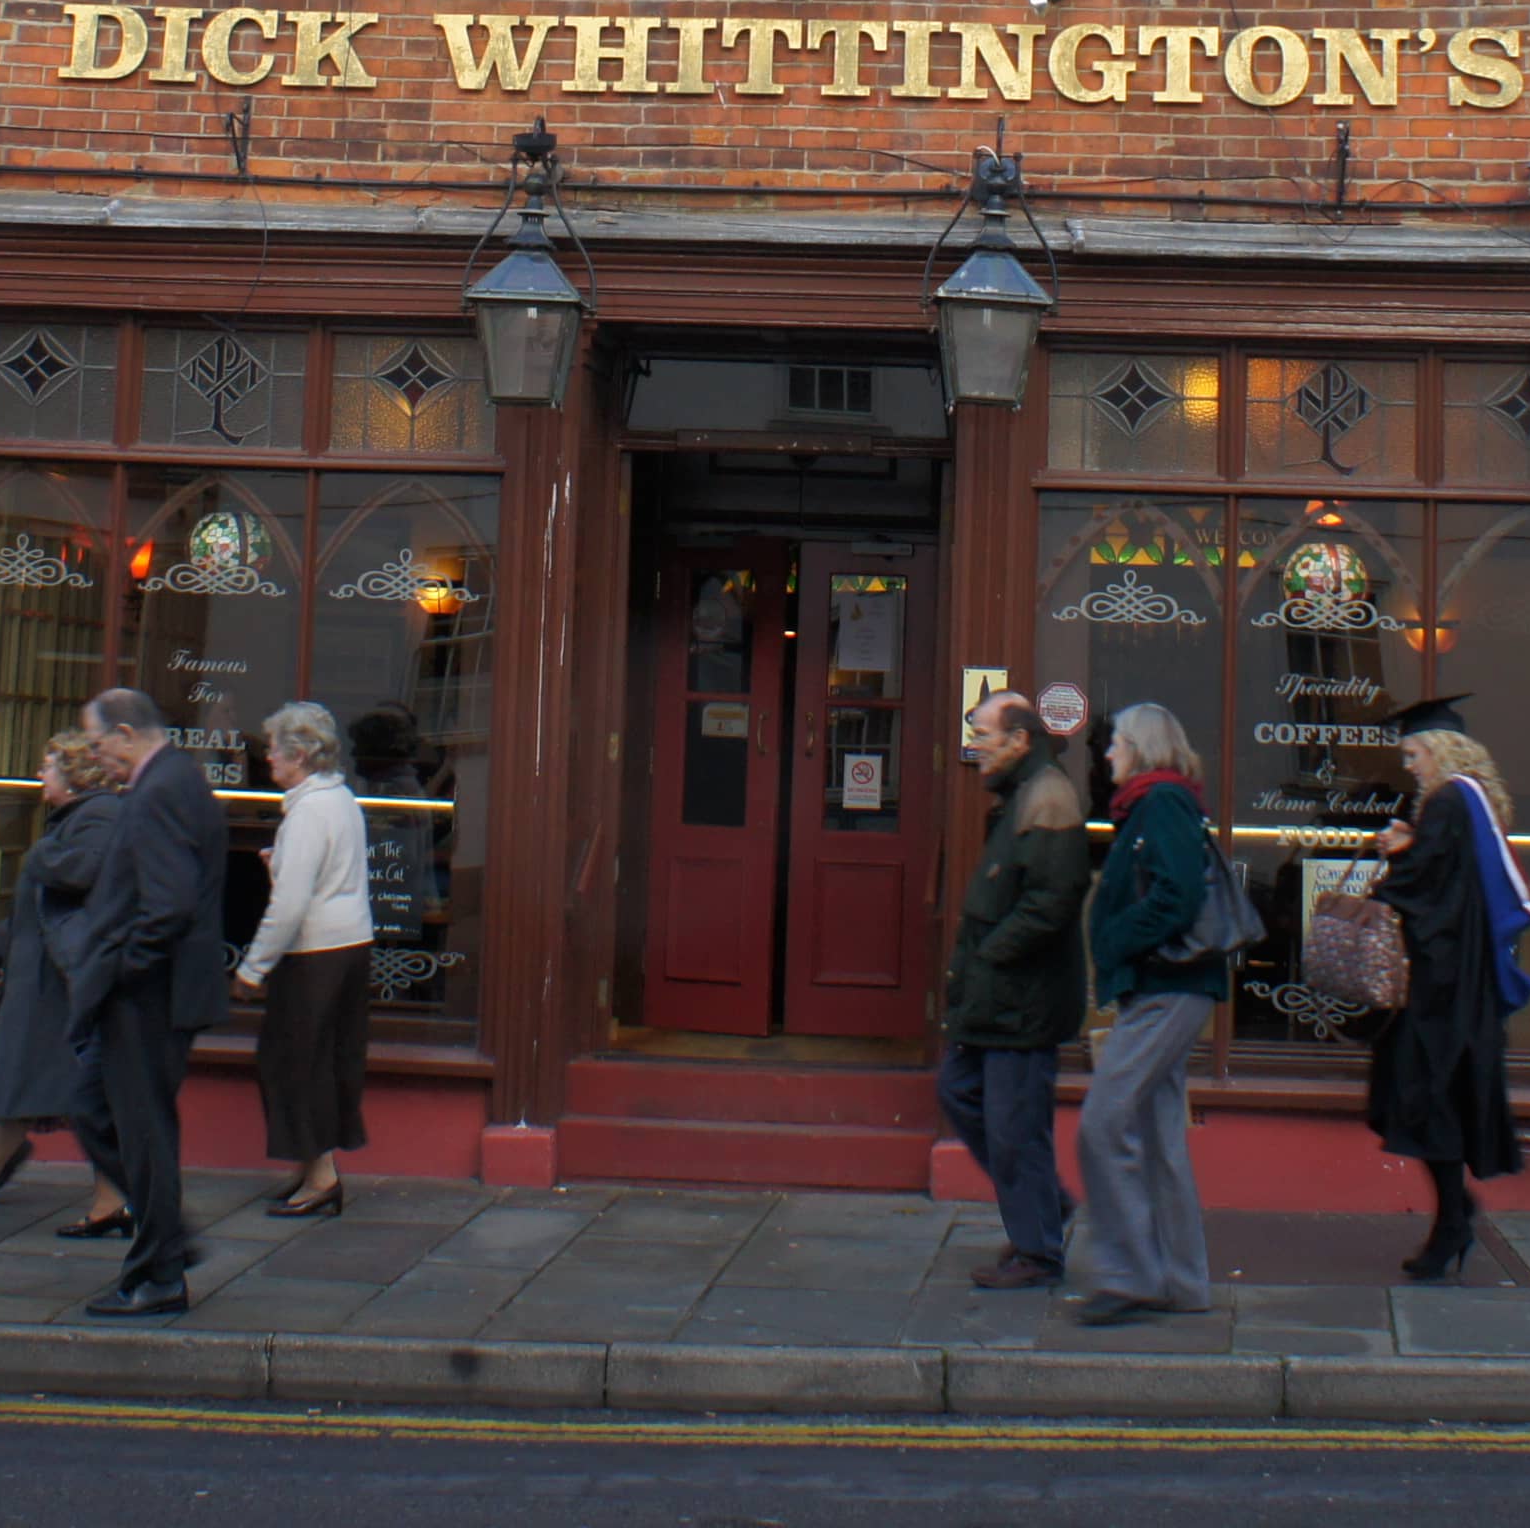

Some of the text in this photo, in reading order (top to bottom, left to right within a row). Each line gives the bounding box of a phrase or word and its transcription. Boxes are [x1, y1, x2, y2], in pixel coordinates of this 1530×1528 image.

[56, 2, 1525, 109] DICK WHITTINGTON'S
[165, 648, 248, 674] Famous
[187, 681, 226, 703] For
[1274, 673, 1381, 705] Speciality
[164, 727, 247, 751] REAL
[1253, 722, 1401, 747] COFFEES
[1315, 759, 1338, 786] &
[1252, 788, 1405, 815] Home Cooked
[1276, 824, 1365, 848] FOOD
